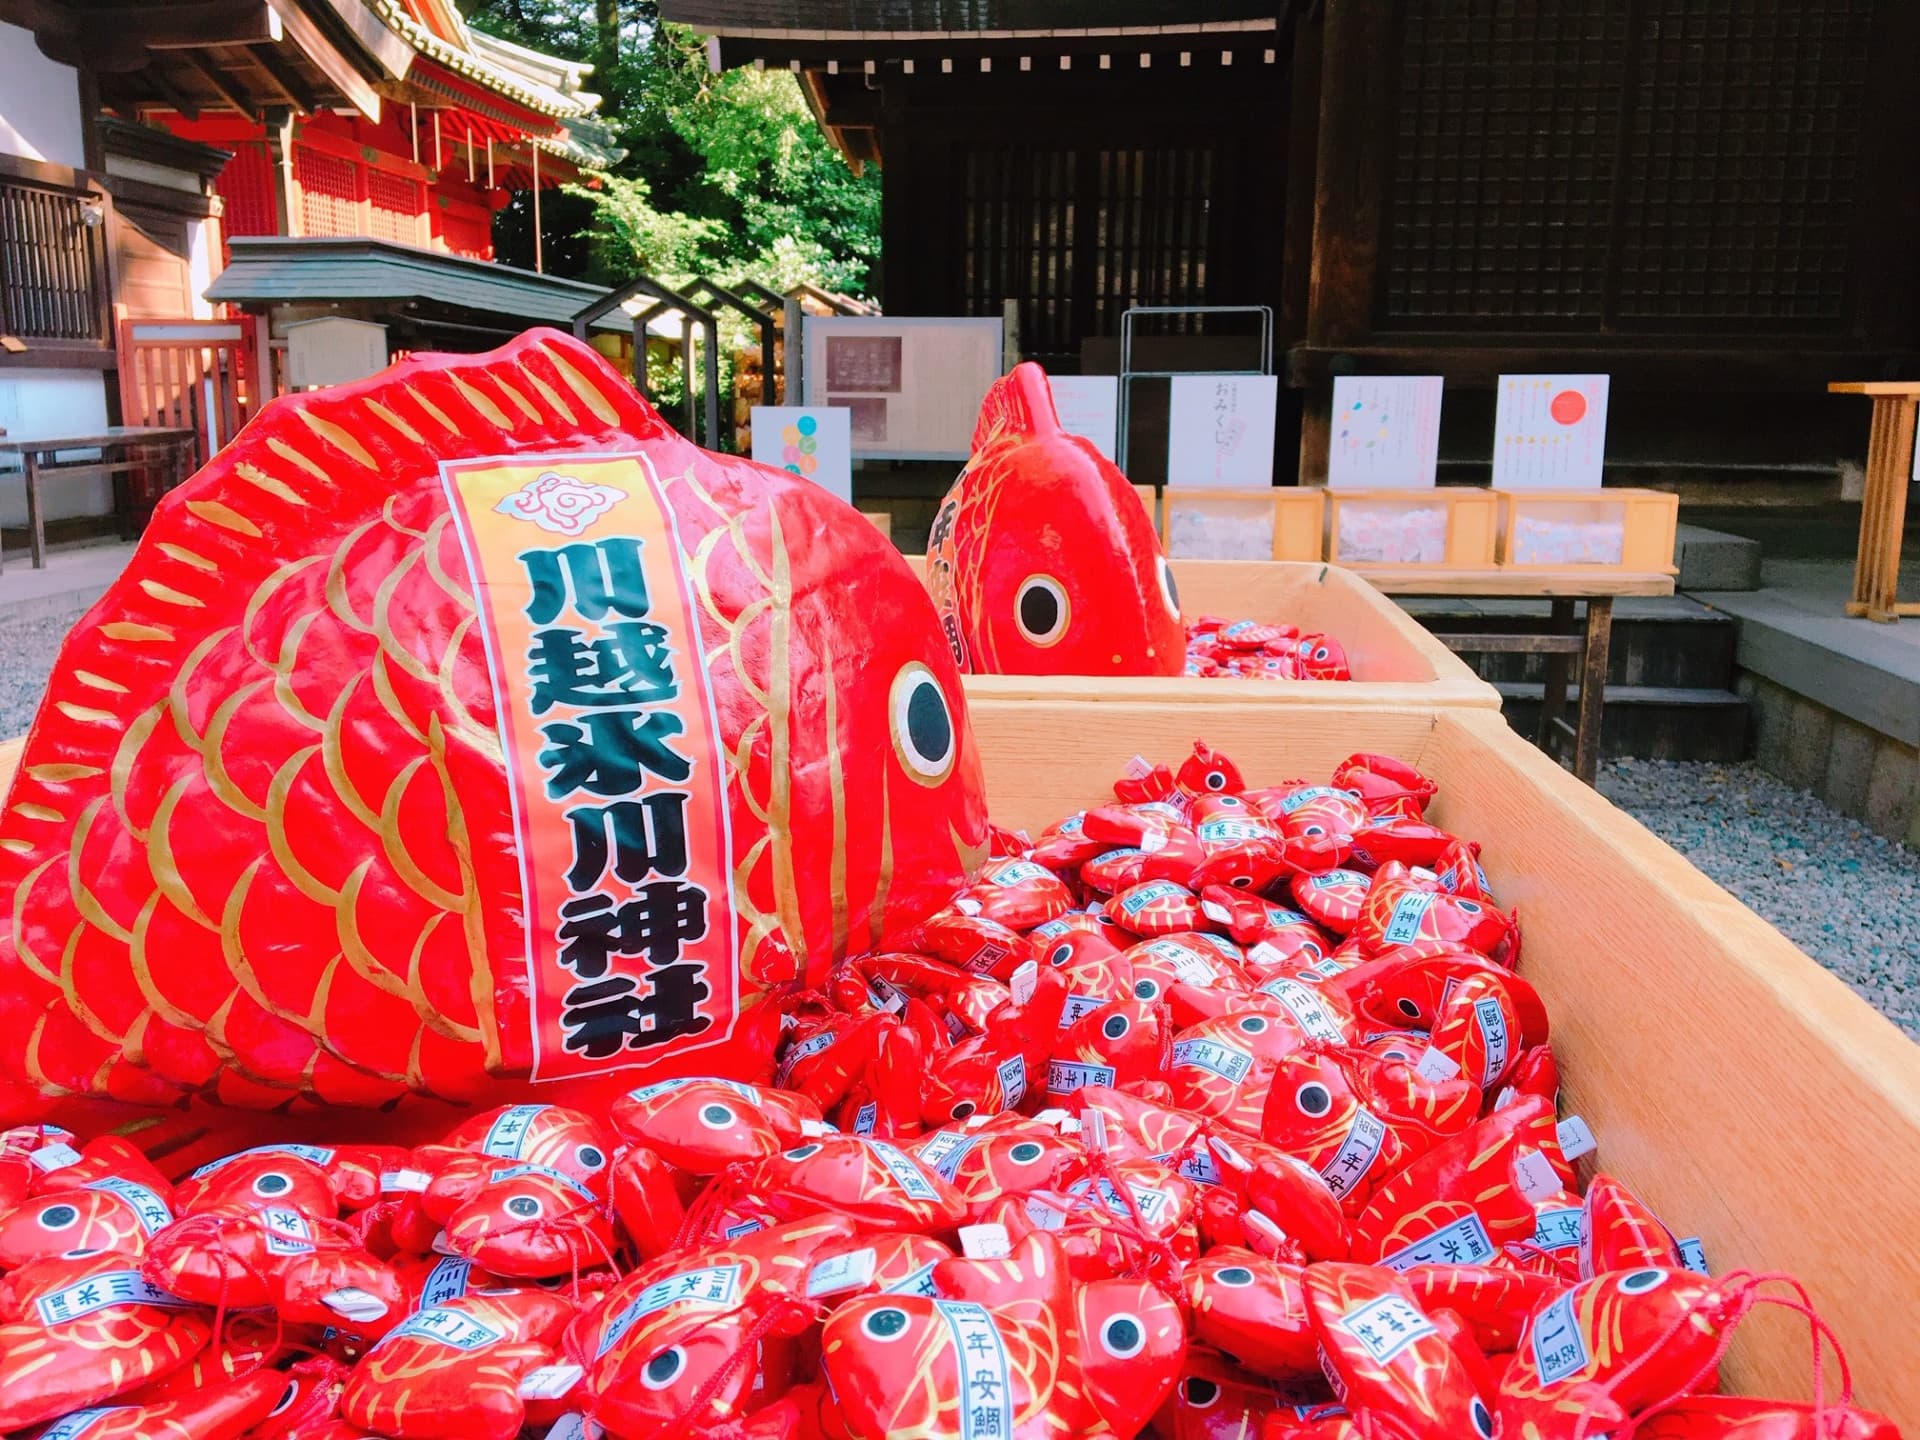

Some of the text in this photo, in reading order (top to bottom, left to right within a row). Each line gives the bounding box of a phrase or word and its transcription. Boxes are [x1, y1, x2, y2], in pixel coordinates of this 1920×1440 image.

[518, 535, 712, 1059] 川越氷川神社
[1358, 1116, 1382, 1141] 招福
[1458, 1225, 1485, 1258] 川越
[706, 1269, 728, 1300] 川越
[959, 1316, 1002, 1438] 一年安鯛
